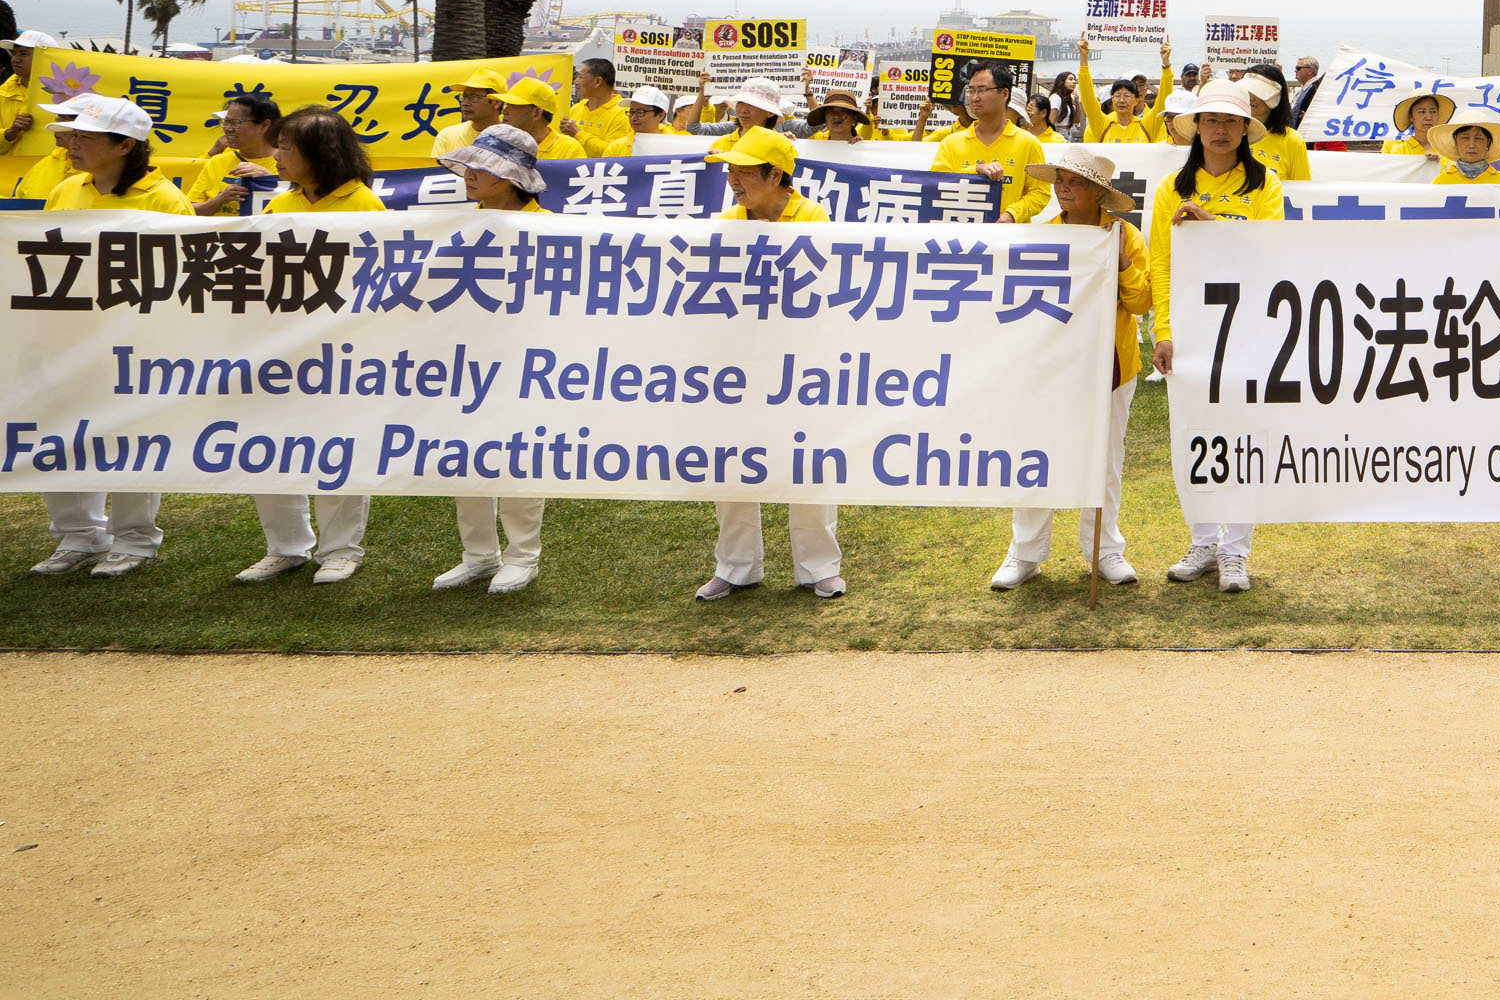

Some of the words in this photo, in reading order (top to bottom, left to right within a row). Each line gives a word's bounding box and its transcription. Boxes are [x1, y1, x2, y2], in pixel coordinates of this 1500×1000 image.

[1088, 23, 1102, 32] Bring
[1103, 24, 1119, 33] Jiang
[1145, 25, 1165, 33] Justice
[1206, 23, 1278, 41] 法辦江澤民
[640, 31, 669, 46] SOS!
[742, 22, 797, 48] SOS!
[1005, 37, 1032, 45] Harvesting
[1098, 34, 1131, 44] Persecuting
[1149, 36, 1163, 44] Gong
[617, 46, 629, 54] U.S.
[631, 47, 651, 56] House
[654, 49, 690, 58] Resolution
[1207, 47, 1221, 55] Bring
[1222, 47, 1235, 55] Jiang
[625, 55, 666, 66] Condemns
[668, 59, 694, 67] Forced
[807, 53, 835, 67] SOS!
[1217, 56, 1247, 64] Persecuting
[618, 64, 632, 72] Live
[634, 65, 656, 74] Organ
[659, 67, 700, 77] Harvesting
[818, 70, 854, 79] Resolution
[831, 79, 857, 87] Forced
[932, 57, 955, 99] SOS!
[1323, 114, 1389, 140] stop
[10, 228, 1073, 325] 立即释放被关押的法轮功学员
[113, 343, 502, 414] Immediately
[519, 346, 747, 405] Release
[766, 352, 953, 407] Jailed
[1, 419, 171, 473] Falun
[193, 420, 355, 490] Gong
[376, 423, 768, 486] Practitioners
[792, 431, 847, 485] in
[872, 432, 1049, 488] China
[1189, 433, 1264, 485] 23th
[1275, 429, 1476, 497] Anniversary
